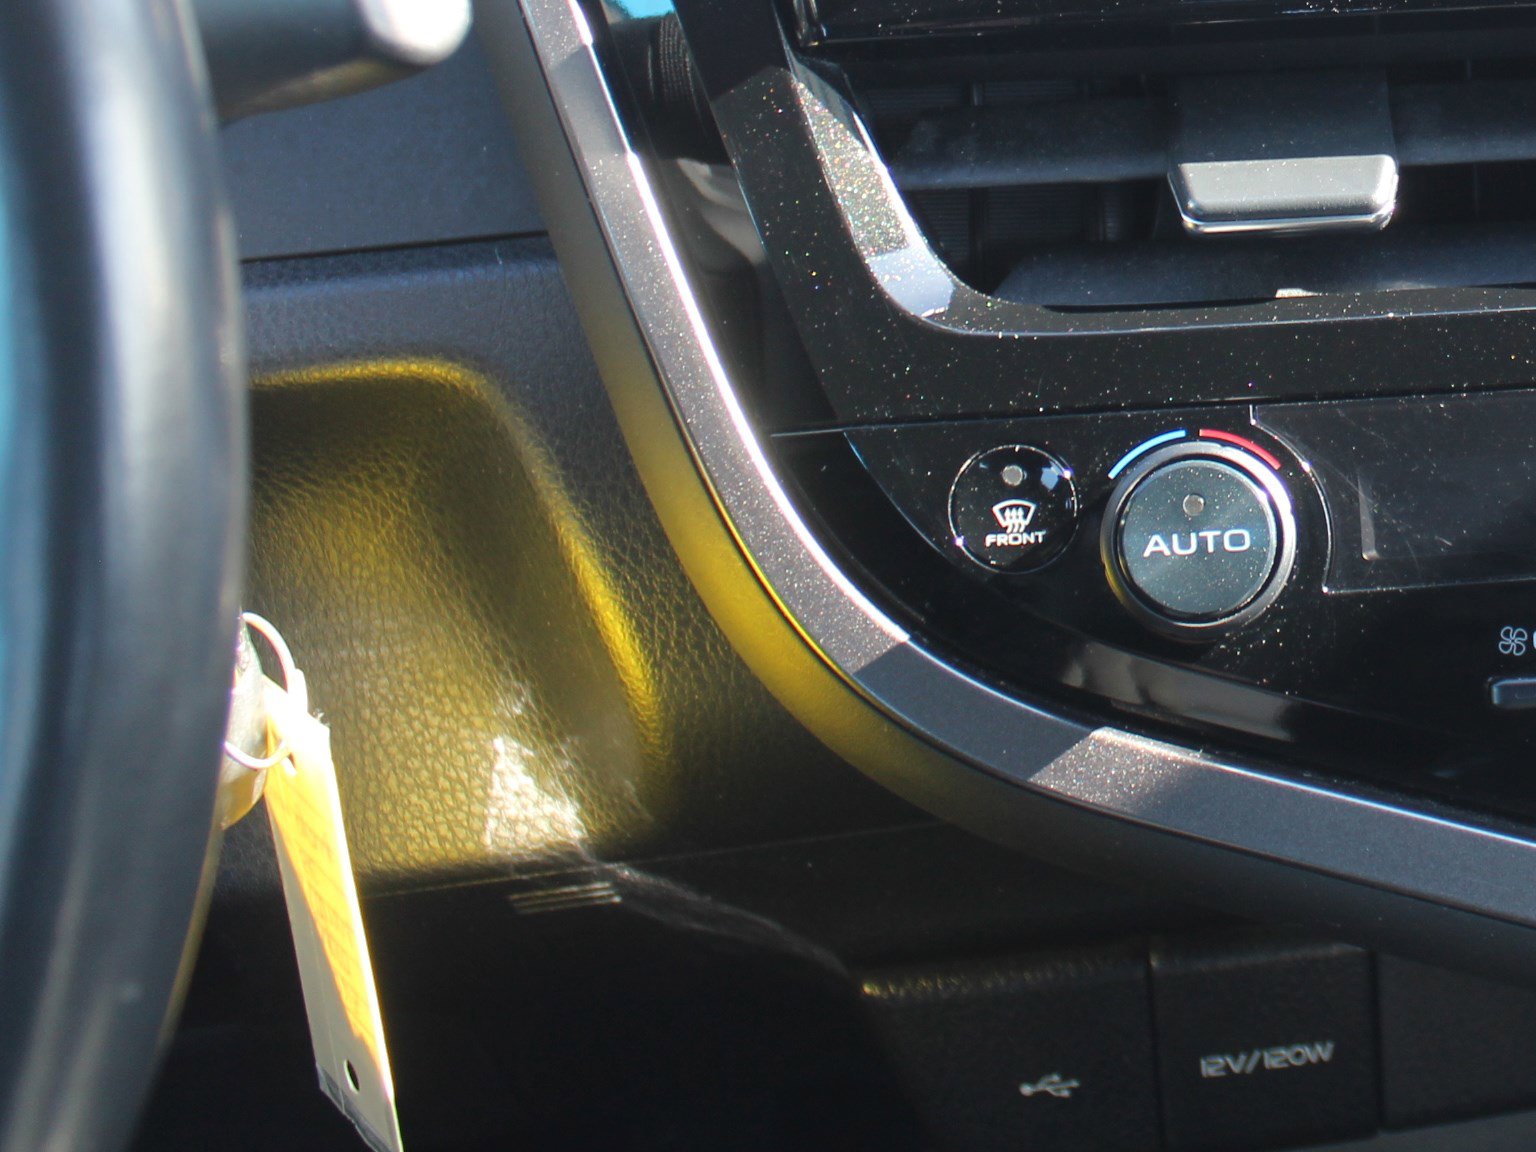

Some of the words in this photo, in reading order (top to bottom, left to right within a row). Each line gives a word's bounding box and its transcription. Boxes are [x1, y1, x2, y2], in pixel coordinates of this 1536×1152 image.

[985, 530, 1047, 547] FRONT
[1143, 529, 1250, 557] AUTO
[1201, 1041, 1335, 1078] 12V/120W
